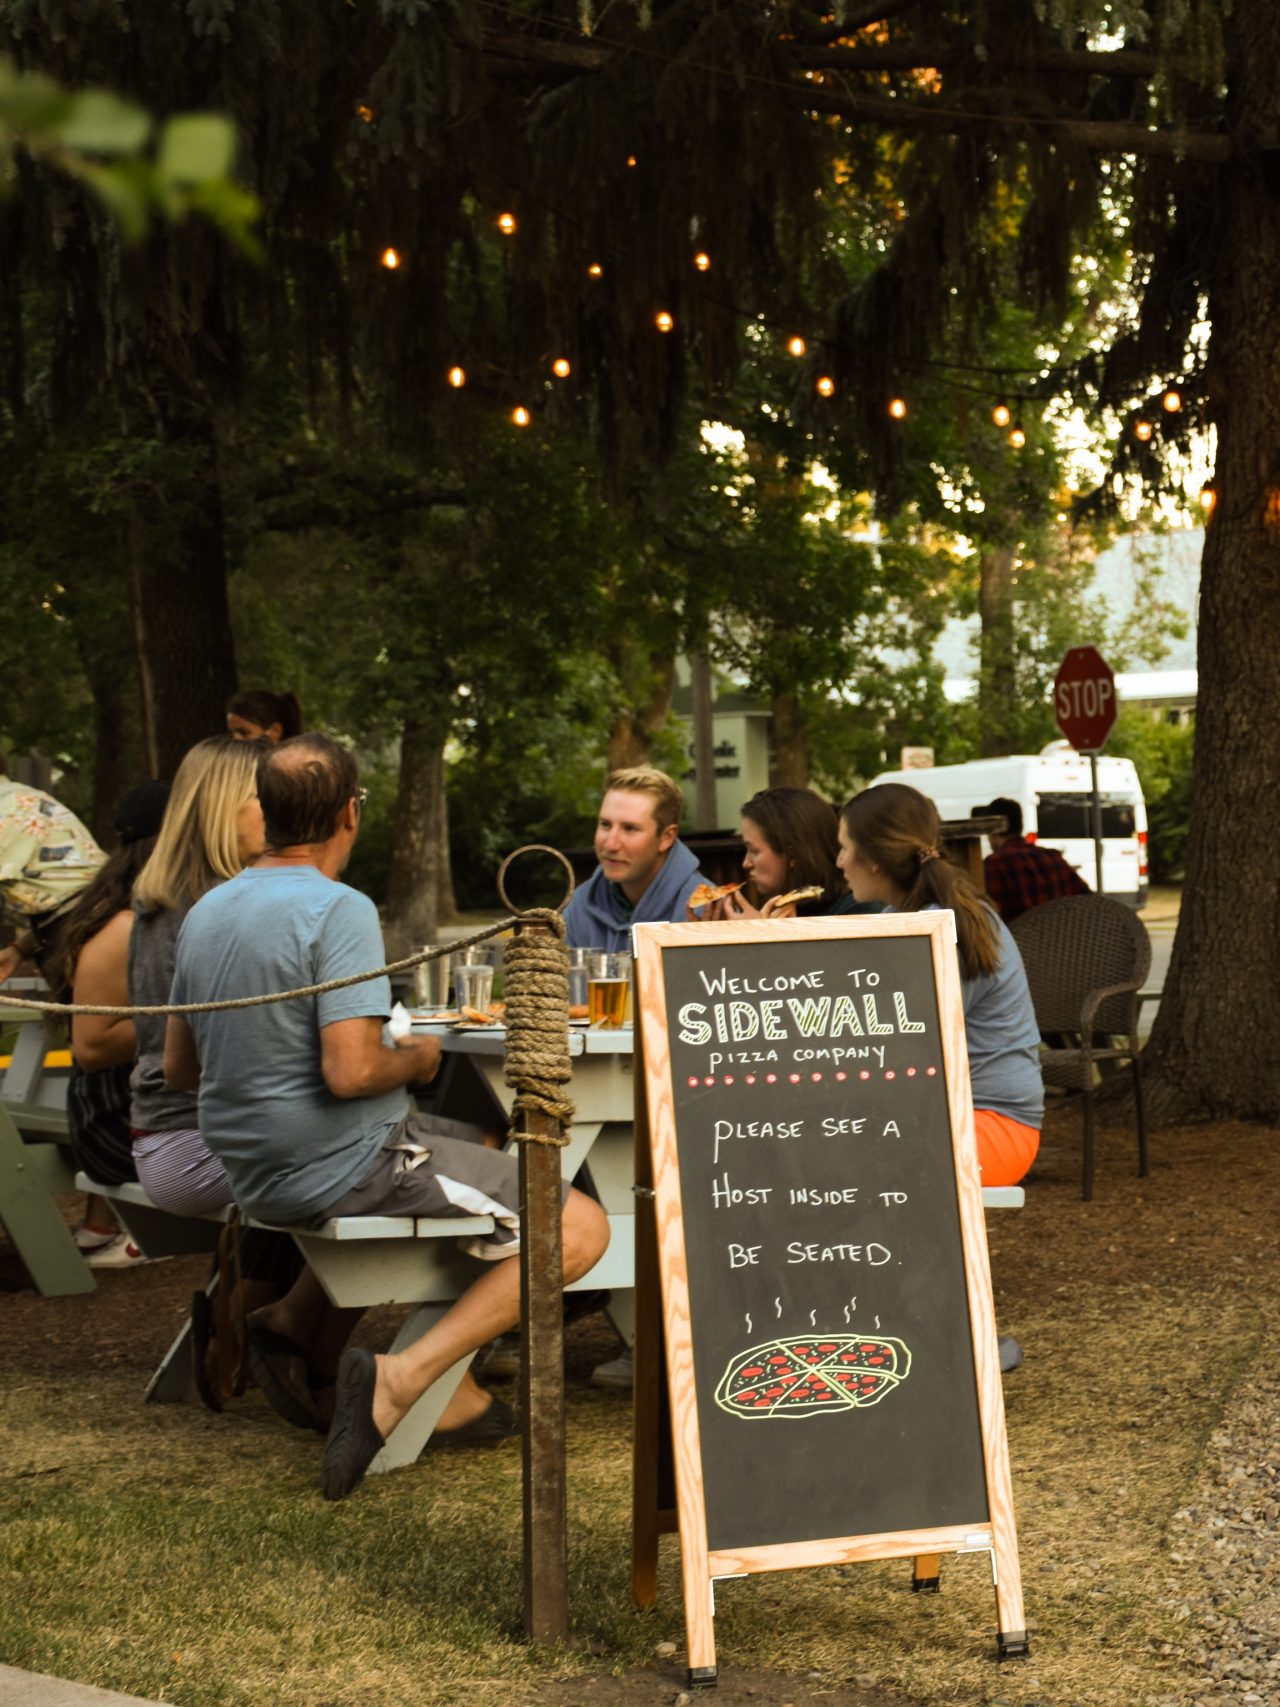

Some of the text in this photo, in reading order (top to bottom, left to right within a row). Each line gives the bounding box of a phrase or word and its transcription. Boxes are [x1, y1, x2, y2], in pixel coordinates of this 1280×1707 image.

[1058, 678, 1112, 720] STOP
[699, 967, 880, 996] WELCOME TO
[678, 991, 926, 1046] SIDEWALL
[710, 1045, 885, 1074] PIZZA COMPANY
[713, 1117, 901, 1164] PLEASE SEE A
[711, 1171, 908, 1209] HOST INSIDE TO
[727, 1242, 763, 1268] BE
